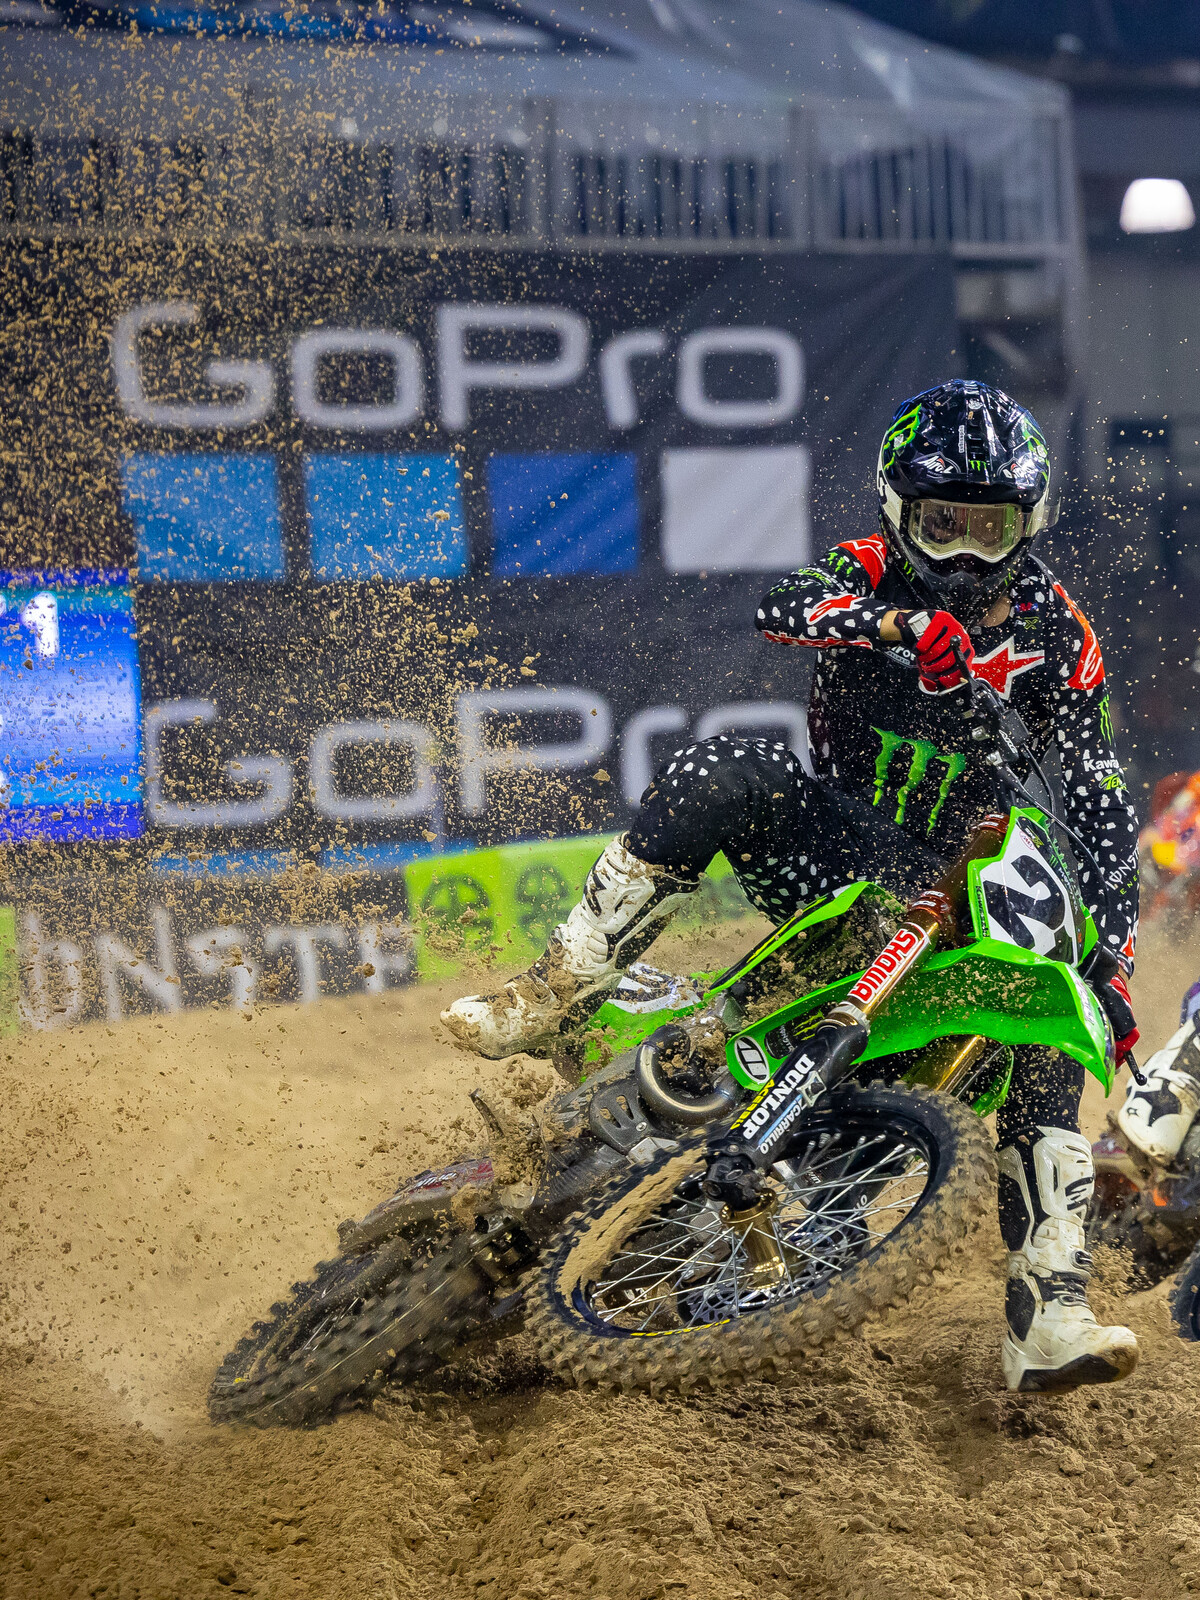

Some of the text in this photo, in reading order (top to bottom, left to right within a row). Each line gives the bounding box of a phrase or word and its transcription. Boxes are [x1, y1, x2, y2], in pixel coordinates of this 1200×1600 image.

[109, 301, 804, 432] GoPro
[144, 684, 809, 828] GoPro
[848, 929, 918, 1003] SHOWA
[743, 1053, 816, 1140] DUNLOP
